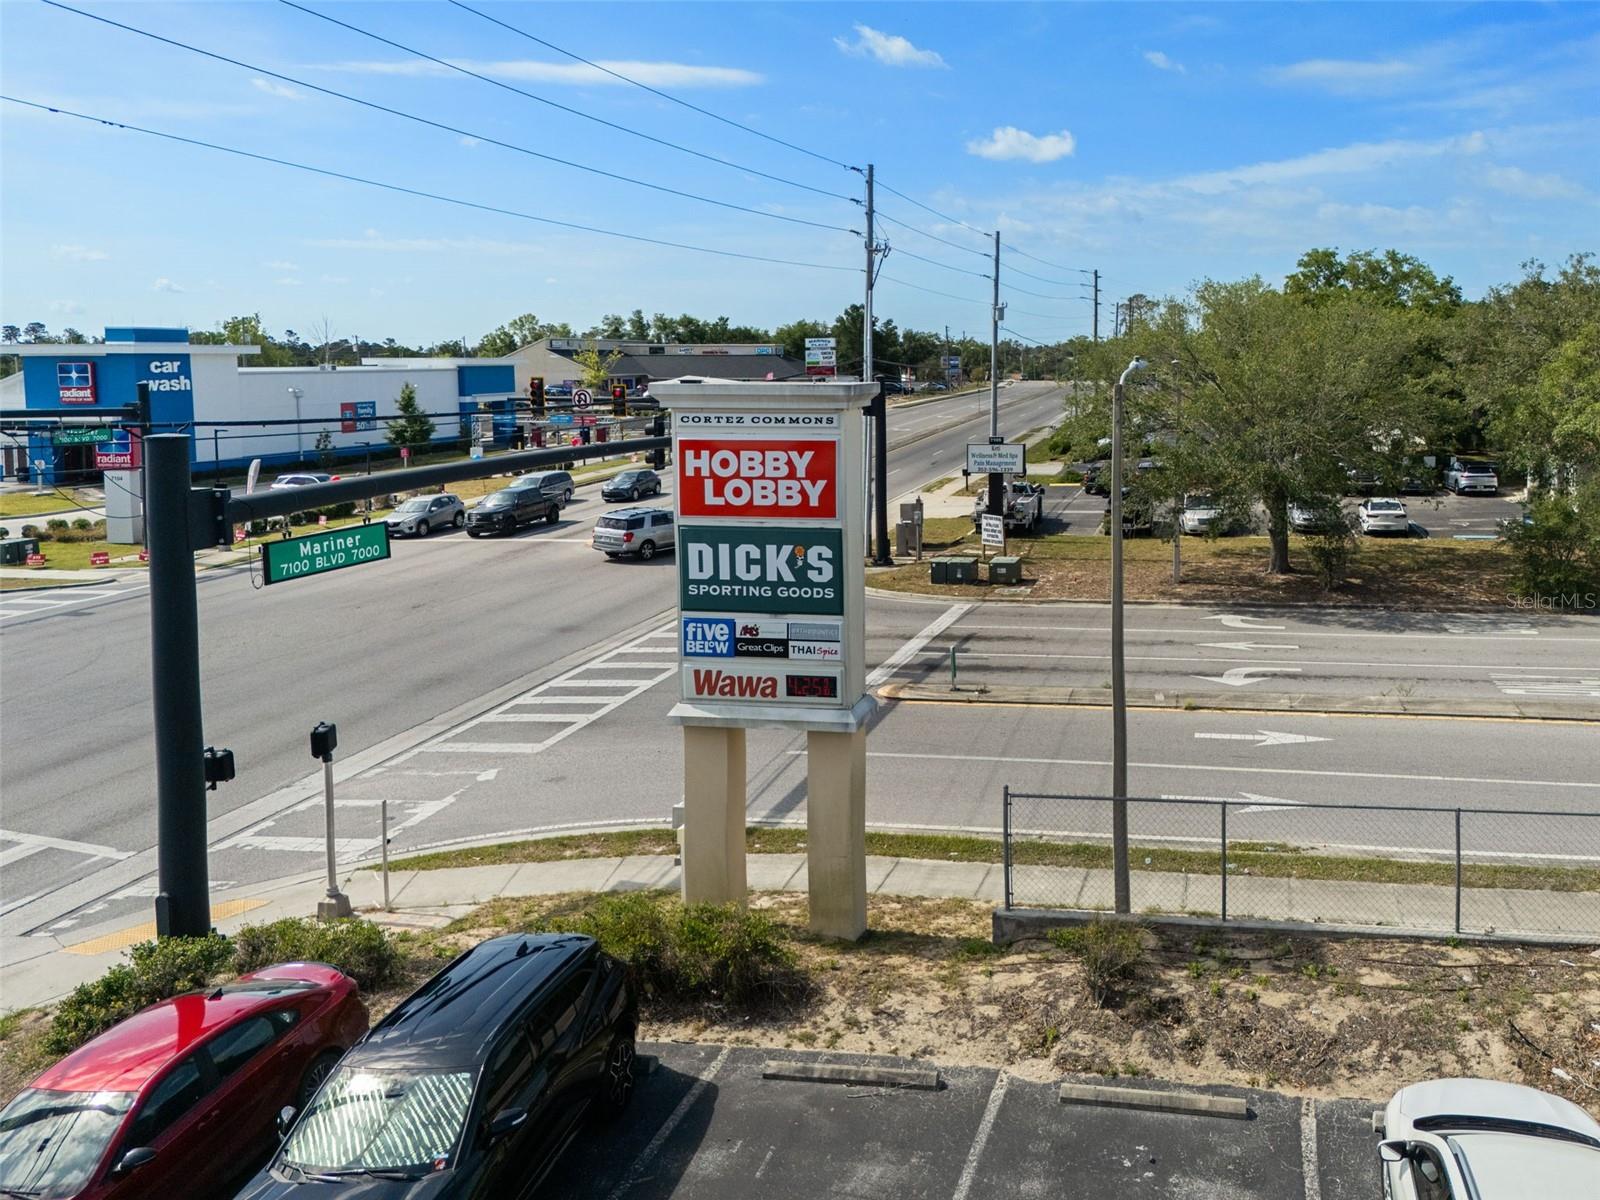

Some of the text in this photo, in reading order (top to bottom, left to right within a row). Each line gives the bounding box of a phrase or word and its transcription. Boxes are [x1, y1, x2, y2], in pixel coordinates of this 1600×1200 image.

[150, 360, 181, 373] car
[59, 388, 92, 398] radiant
[680, 415, 835, 425] CORTEZ COMMONS
[97, 454, 131, 463] radiant
[685, 449, 815, 479] HOBBY
[704, 479, 827, 508] LOBBY
[299, 535, 361, 558] Mariner
[280, 545, 380, 576] 7100 BLVD 7000
[687, 542, 834, 583] DICK'S
[688, 585, 834, 599] SPORTING GOODS
[686, 622, 729, 642] five
[737, 642, 784, 654] Great Clips
[791, 645, 839, 659] THAI Spice
[693, 668, 778, 699] Wawa
